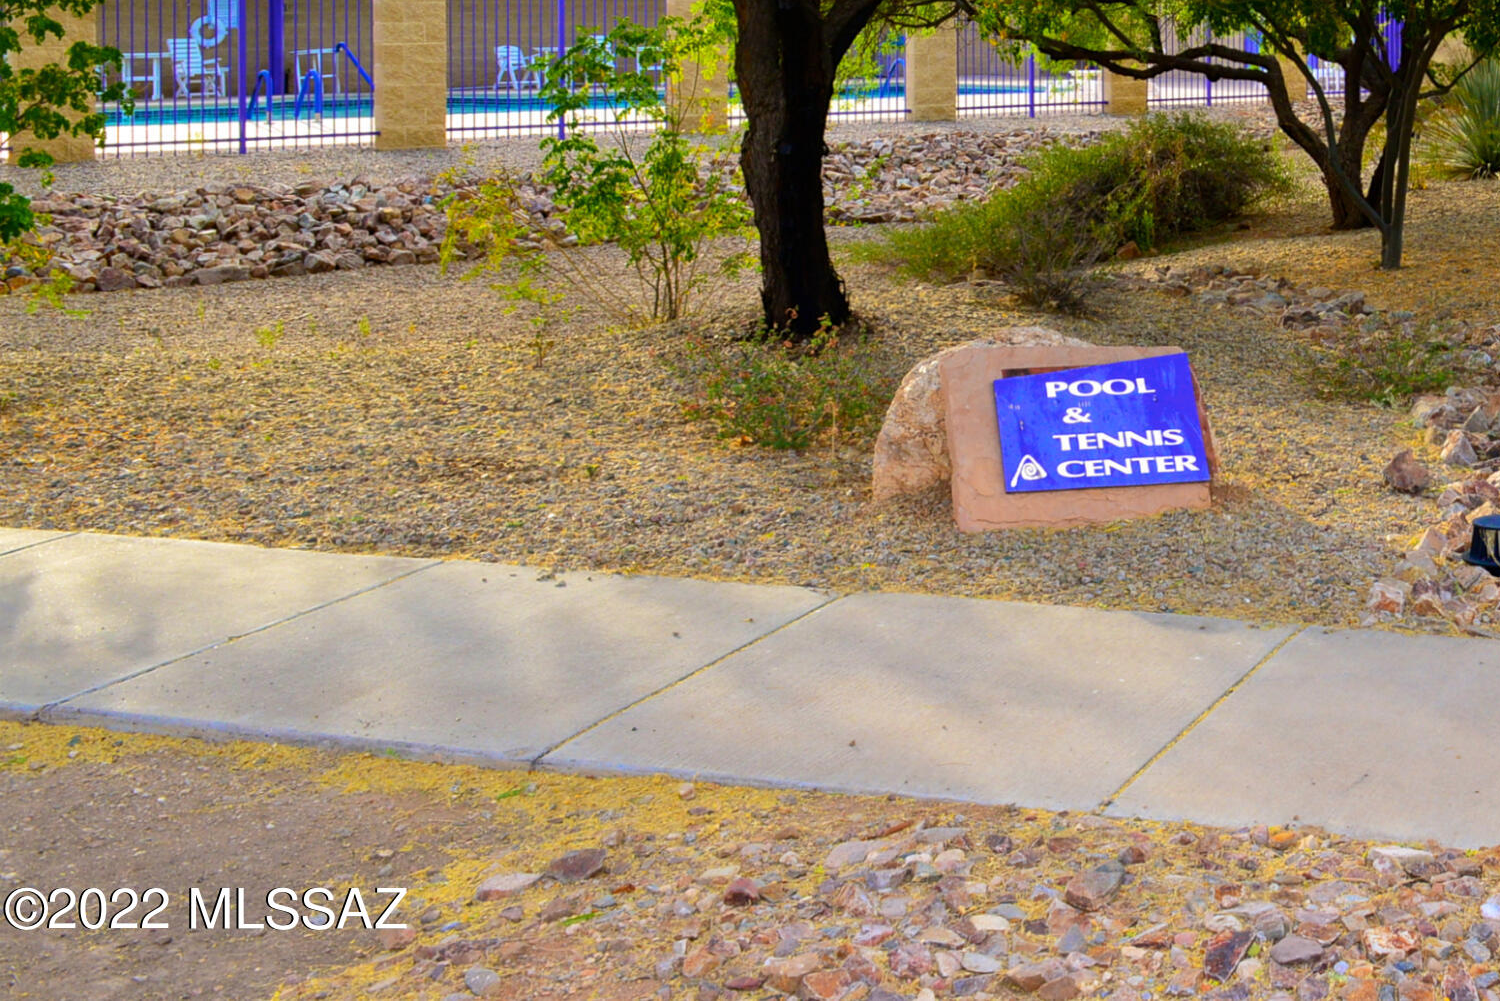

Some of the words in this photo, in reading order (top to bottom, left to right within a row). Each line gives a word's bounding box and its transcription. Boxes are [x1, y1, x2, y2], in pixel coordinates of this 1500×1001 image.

[1045, 377, 1156, 398] POOL
[1062, 407, 1092, 424] &
[1052, 428, 1184, 451] TENNIS
[1056, 454, 1200, 478] CENTER
